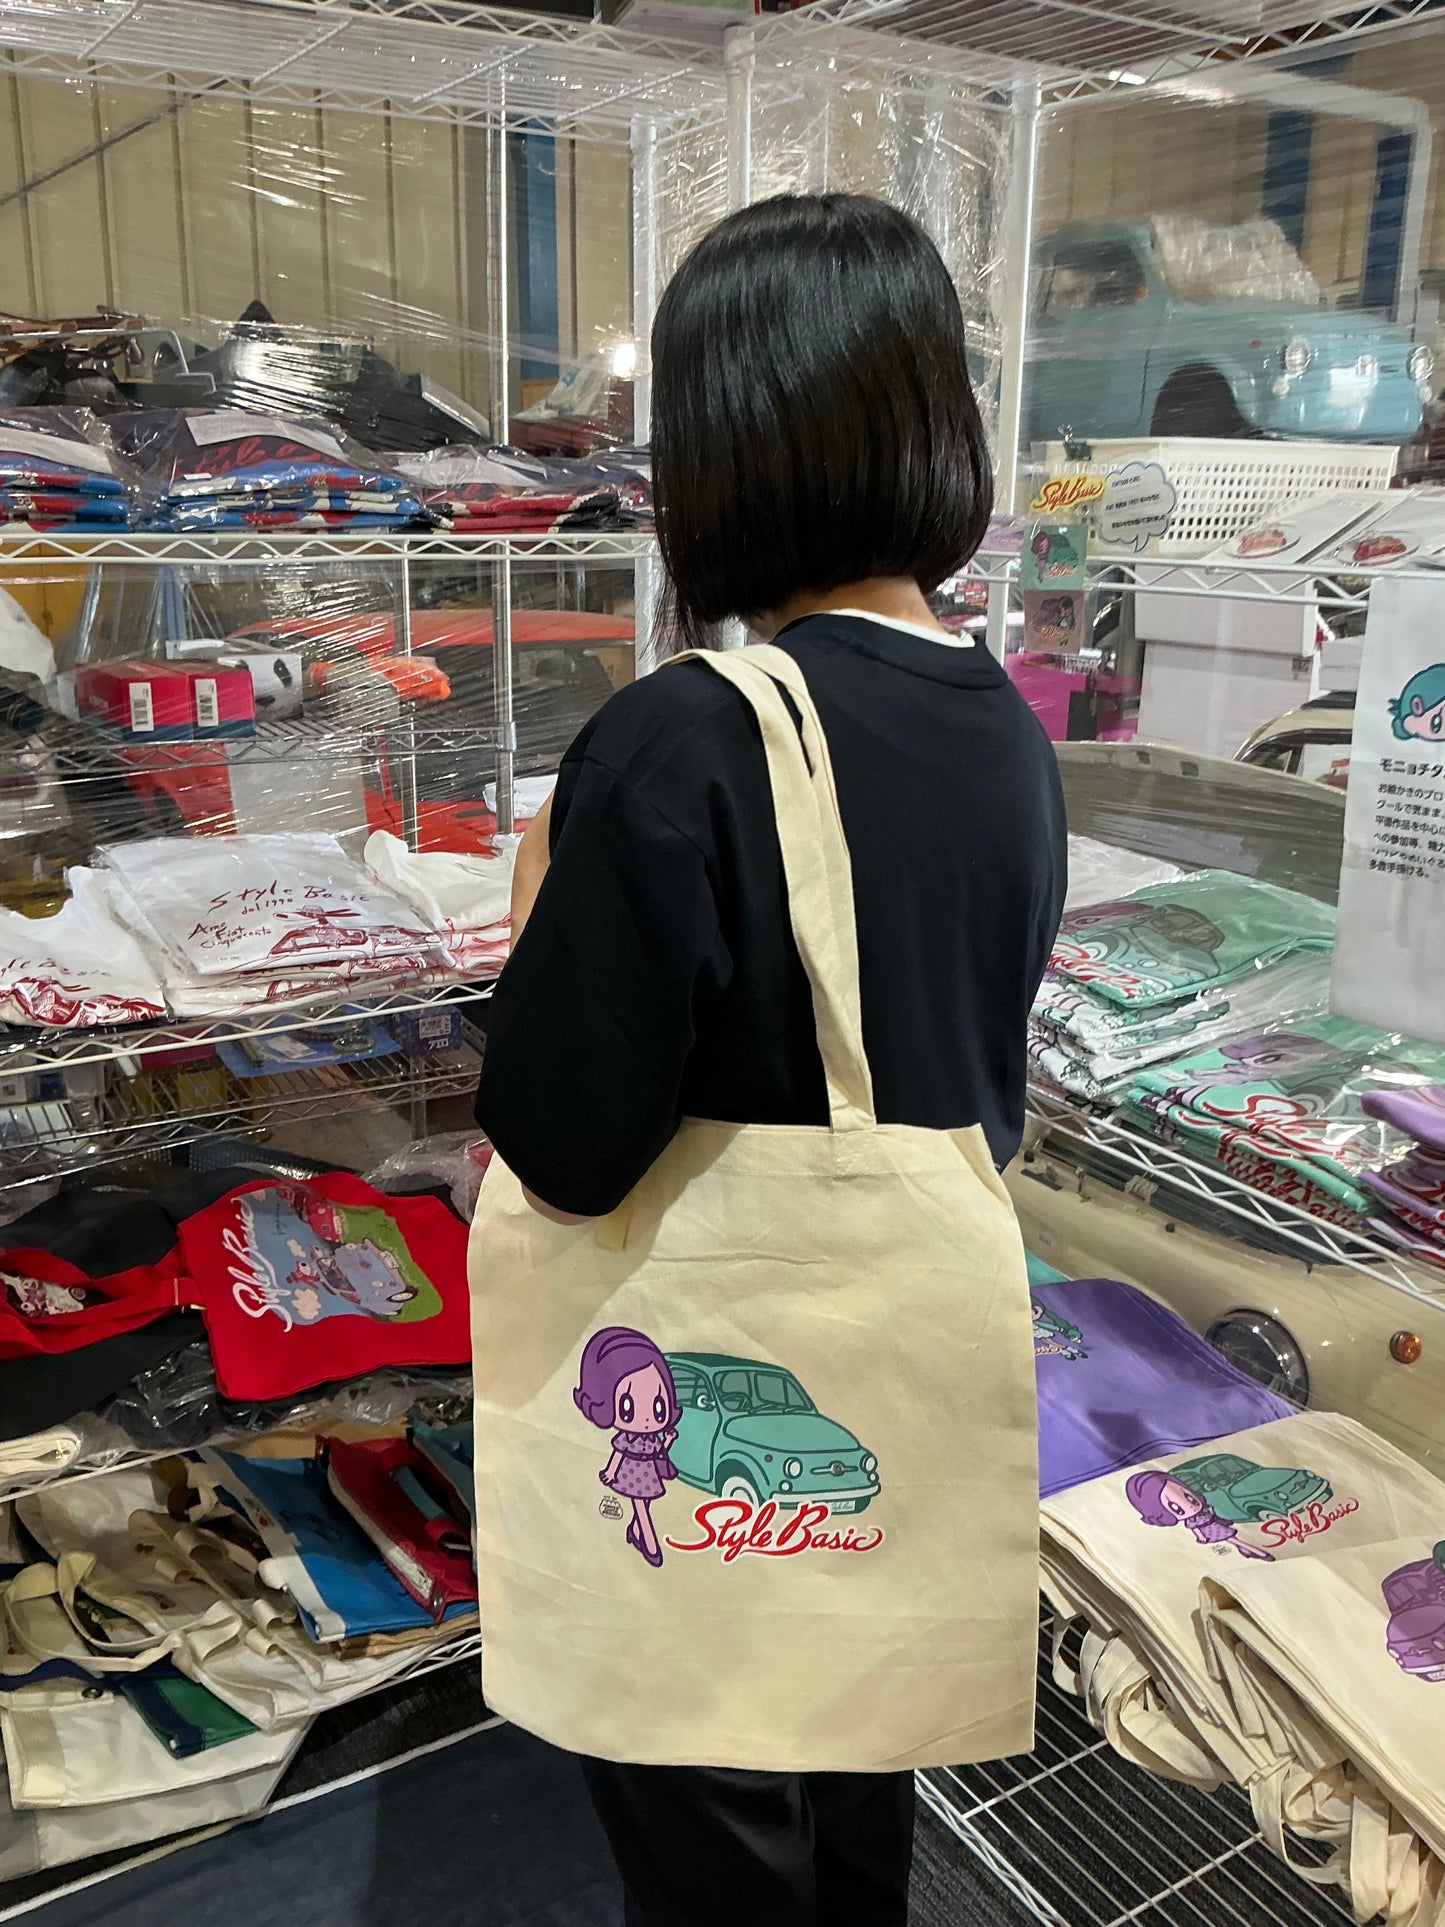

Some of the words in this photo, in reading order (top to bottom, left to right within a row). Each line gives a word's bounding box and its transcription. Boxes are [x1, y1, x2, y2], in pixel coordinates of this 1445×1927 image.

[1032, 480, 1067, 511] Style
[1067, 475, 1103, 504] Basic
[1380, 758, 1445, 778] モニョチタ
[207, 880, 293, 915] Style
[303, 885, 370, 902] Basic
[241, 902, 261, 916] dal
[215, 925, 246, 940] Fiat
[222, 1197, 278, 1278] Basic
[228, 1265, 292, 1332] Style
[665, 1500, 773, 1563] Style
[774, 1503, 883, 1556] Basic
[1260, 1512, 1313, 1549] Style
[1305, 1496, 1360, 1535] Basic
